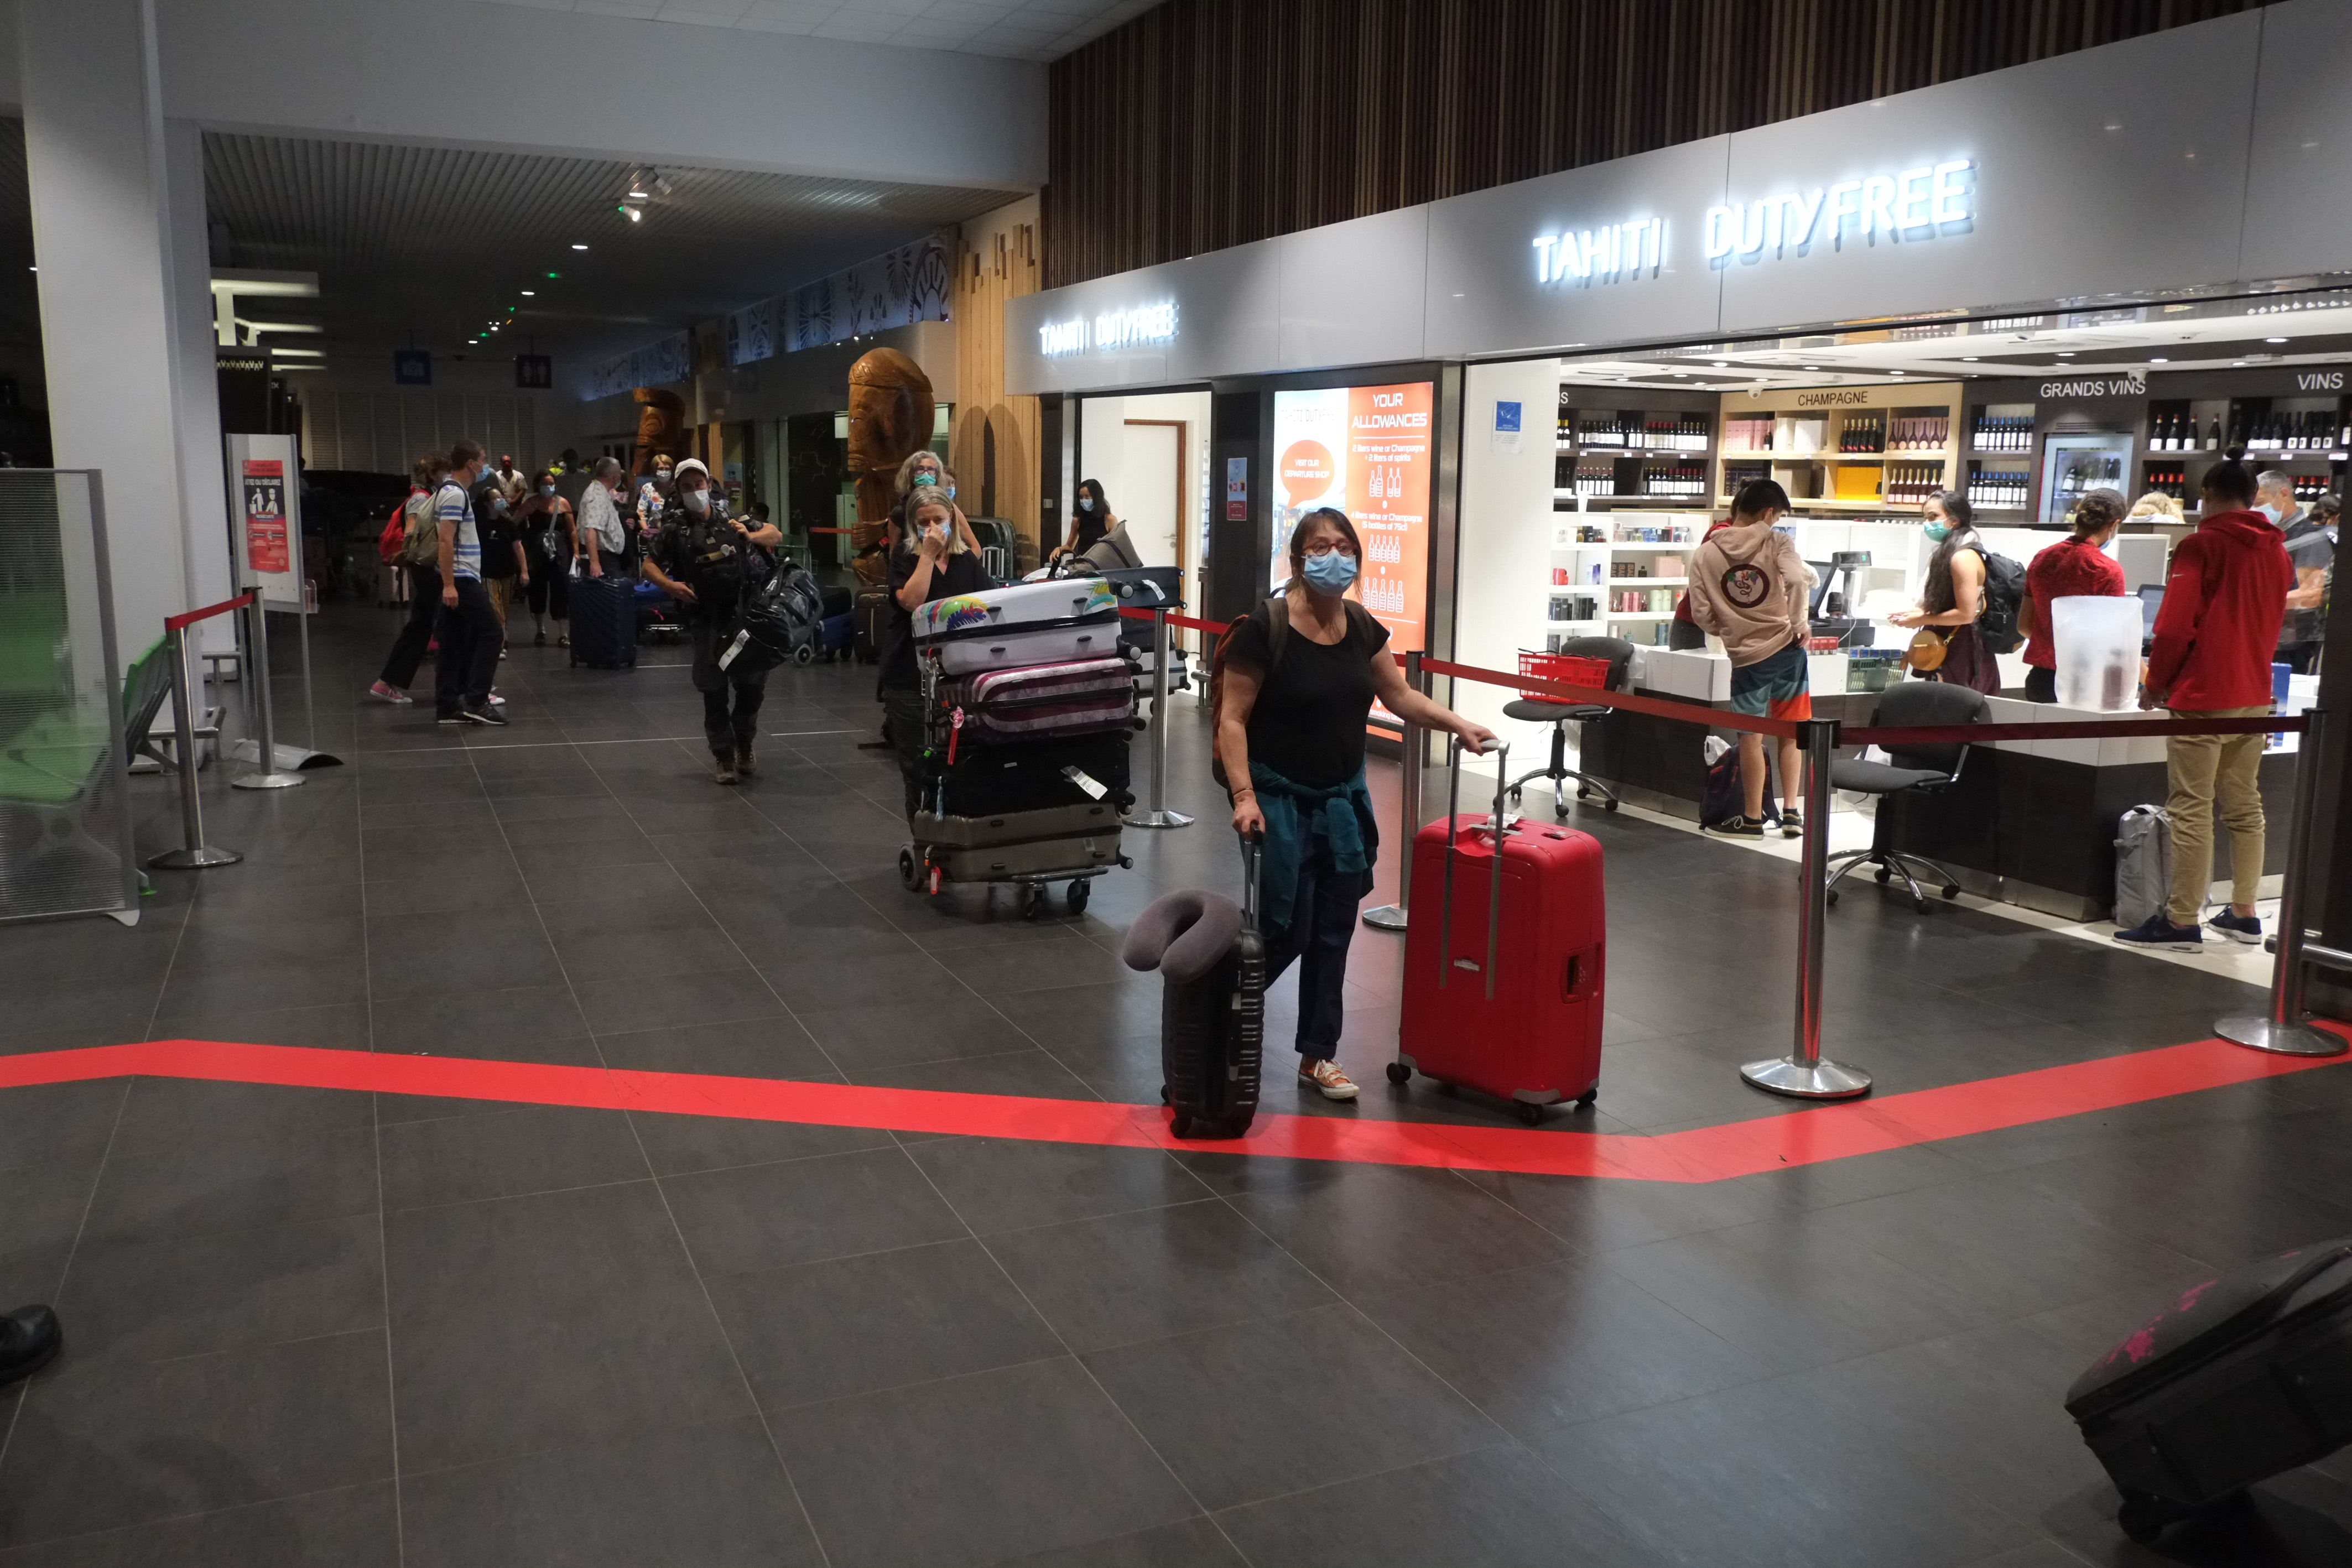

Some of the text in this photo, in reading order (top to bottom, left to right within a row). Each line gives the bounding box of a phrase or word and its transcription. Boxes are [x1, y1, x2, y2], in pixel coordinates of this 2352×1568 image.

[1533, 159, 1973, 283] TAHITI DUTYFREE
[1039, 304, 1175, 355] TAHITI DUTYFREE
[2040, 379, 2146, 398] GRANDS VINS
[2297, 372, 2344, 390] VINS
[1372, 392, 1403, 408] YOUR
[1798, 390, 1869, 407] CHAMPAGNE
[1351, 413, 1428, 429] ALLOWANCES
[1352, 444, 1357, 452] 2
[1357, 444, 1370, 452] liters
[1371, 444, 1383, 452] wine
[1391, 444, 1425, 454] Champagne
[1294, 459, 1320, 467] VISIT OUR
[1368, 454, 1373, 462] 2
[1373, 454, 1387, 462] liters
[1387, 453, 1394, 462] of
[1394, 453, 1412, 463] spirits
[1284, 470, 1330, 478] DEPARTURE SHOP
[1368, 512, 1381, 520] wine
[1388, 513, 1423, 524] Champagne
[1368, 521, 1387, 530] bottles
[1387, 522, 1393, 530] of
